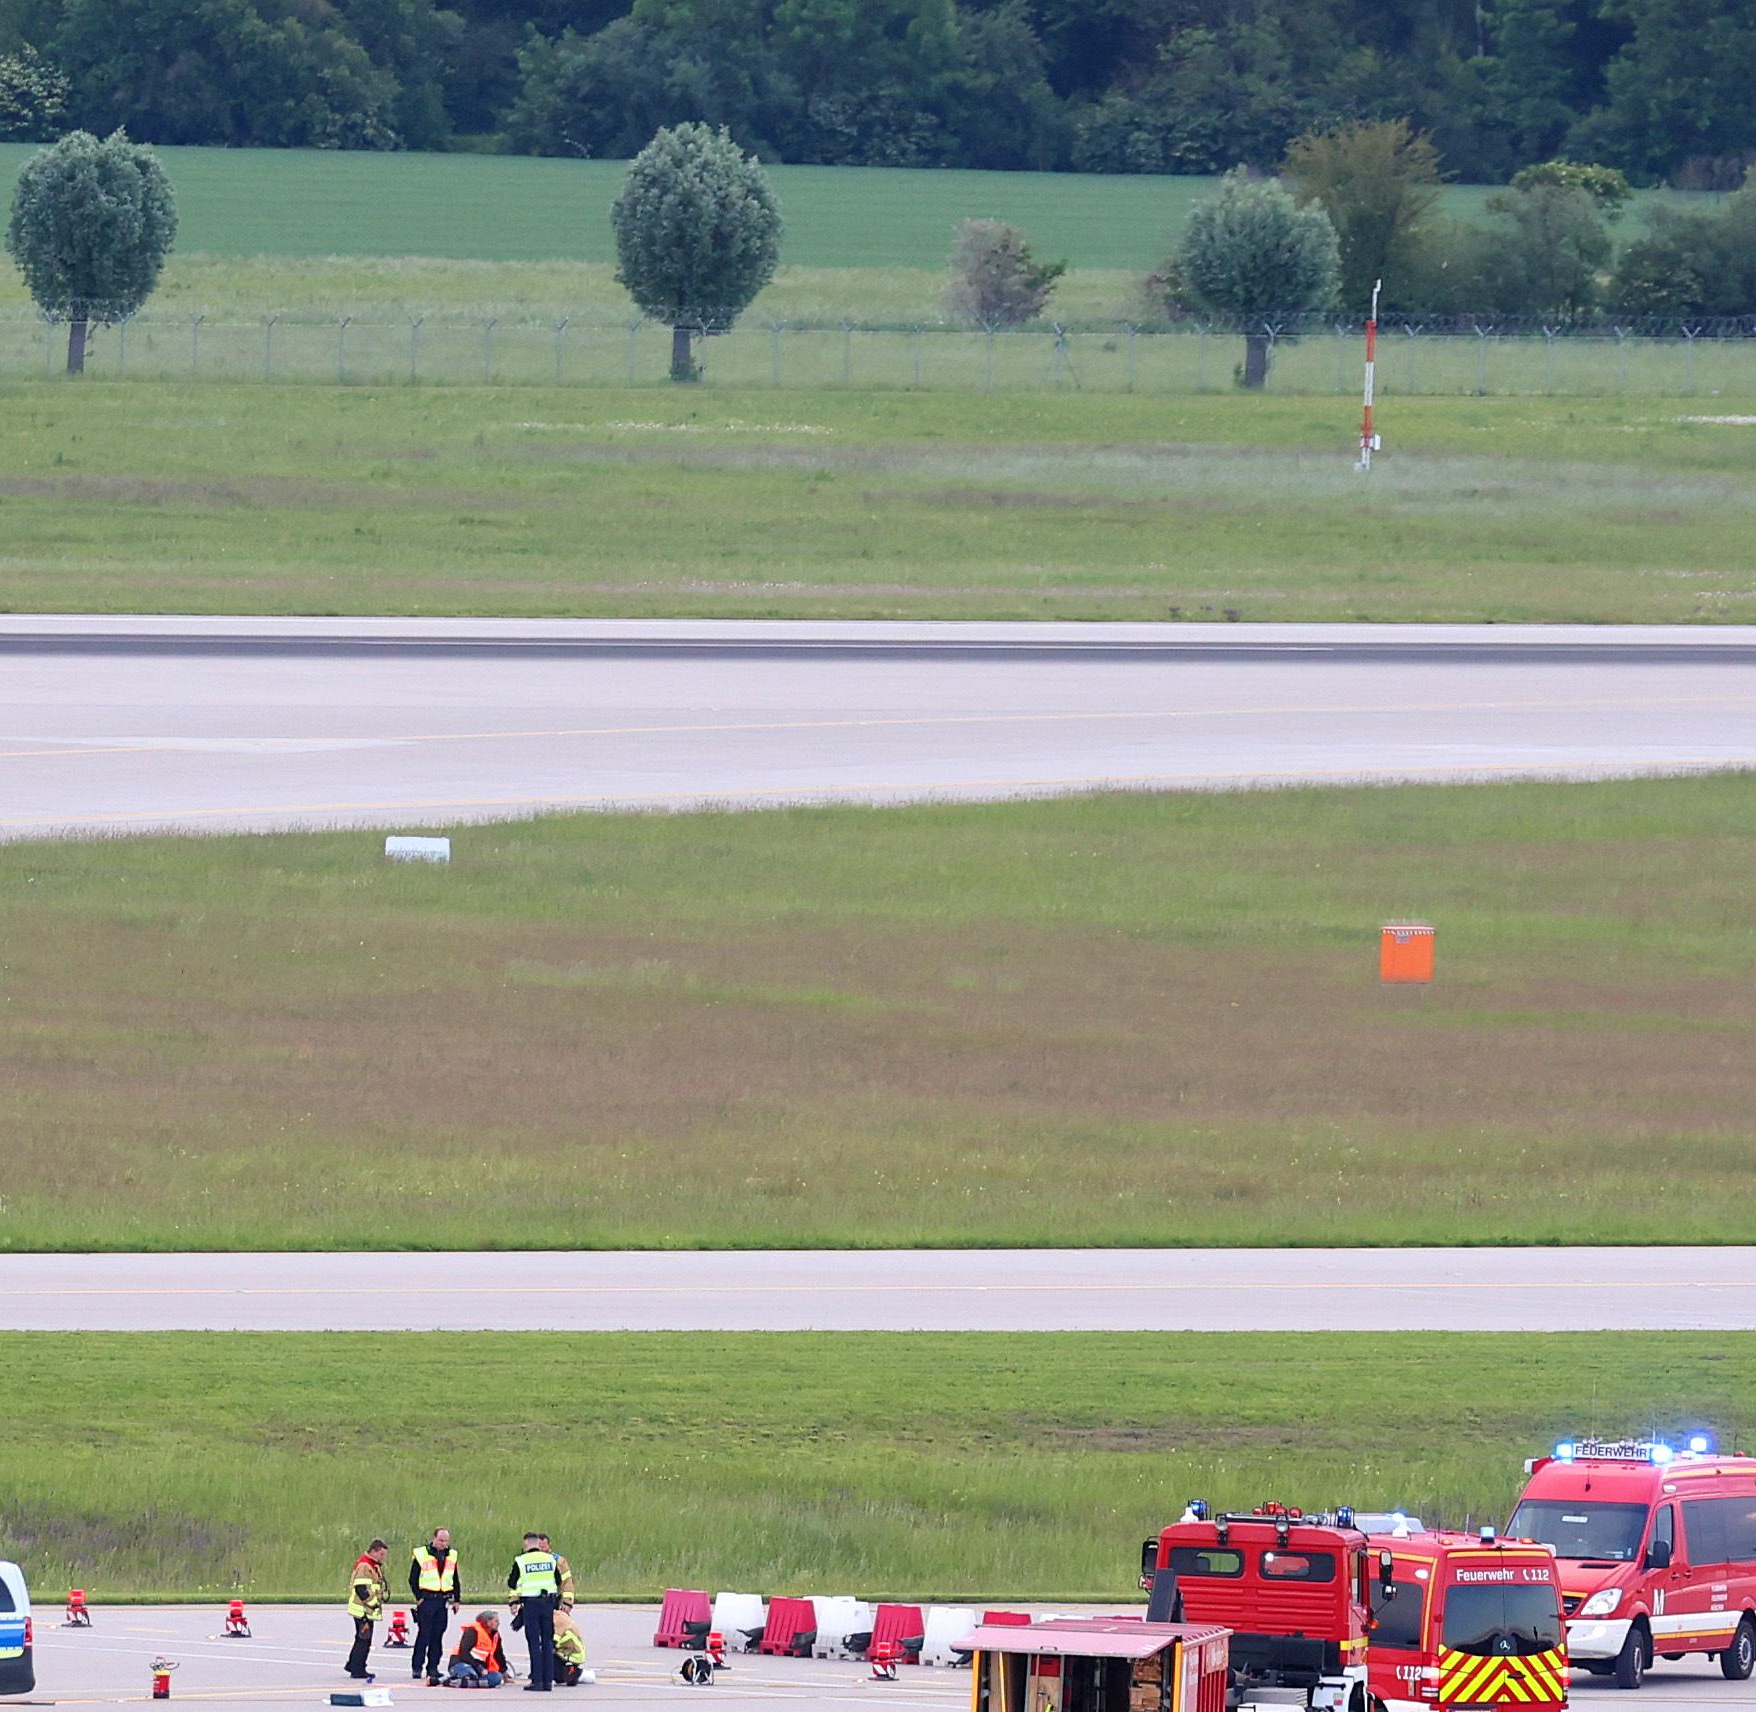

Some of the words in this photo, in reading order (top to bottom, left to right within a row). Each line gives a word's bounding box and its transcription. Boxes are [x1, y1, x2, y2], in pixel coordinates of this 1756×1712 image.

[1575, 1446, 1648, 1458] FEUERWEHR
[1456, 1568, 1515, 1581] Feuerwehr
[1531, 1569, 1550, 1581] 112
[1653, 1588, 1665, 1616] M
[1402, 1666, 1422, 1681] 112
